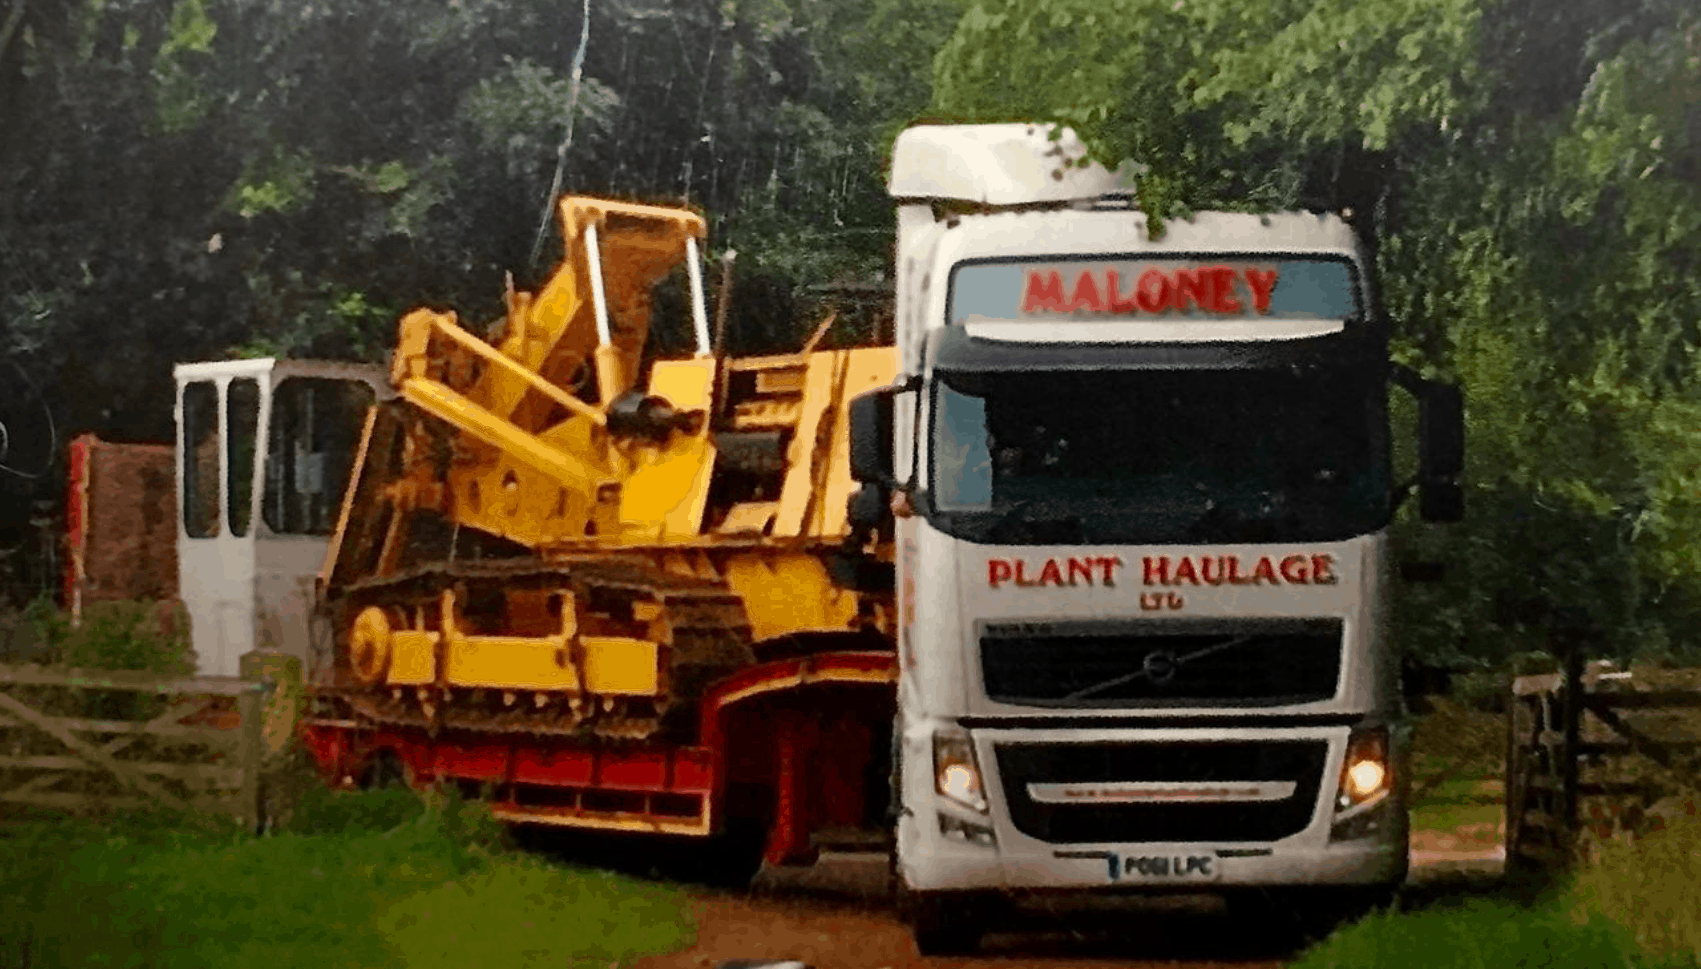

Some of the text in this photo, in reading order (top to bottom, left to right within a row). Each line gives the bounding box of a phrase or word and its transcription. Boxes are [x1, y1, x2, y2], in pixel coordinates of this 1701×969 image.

[1022, 267, 1279, 316] MALONEY
[987, 553, 1338, 587] PLANT HAULAGE
